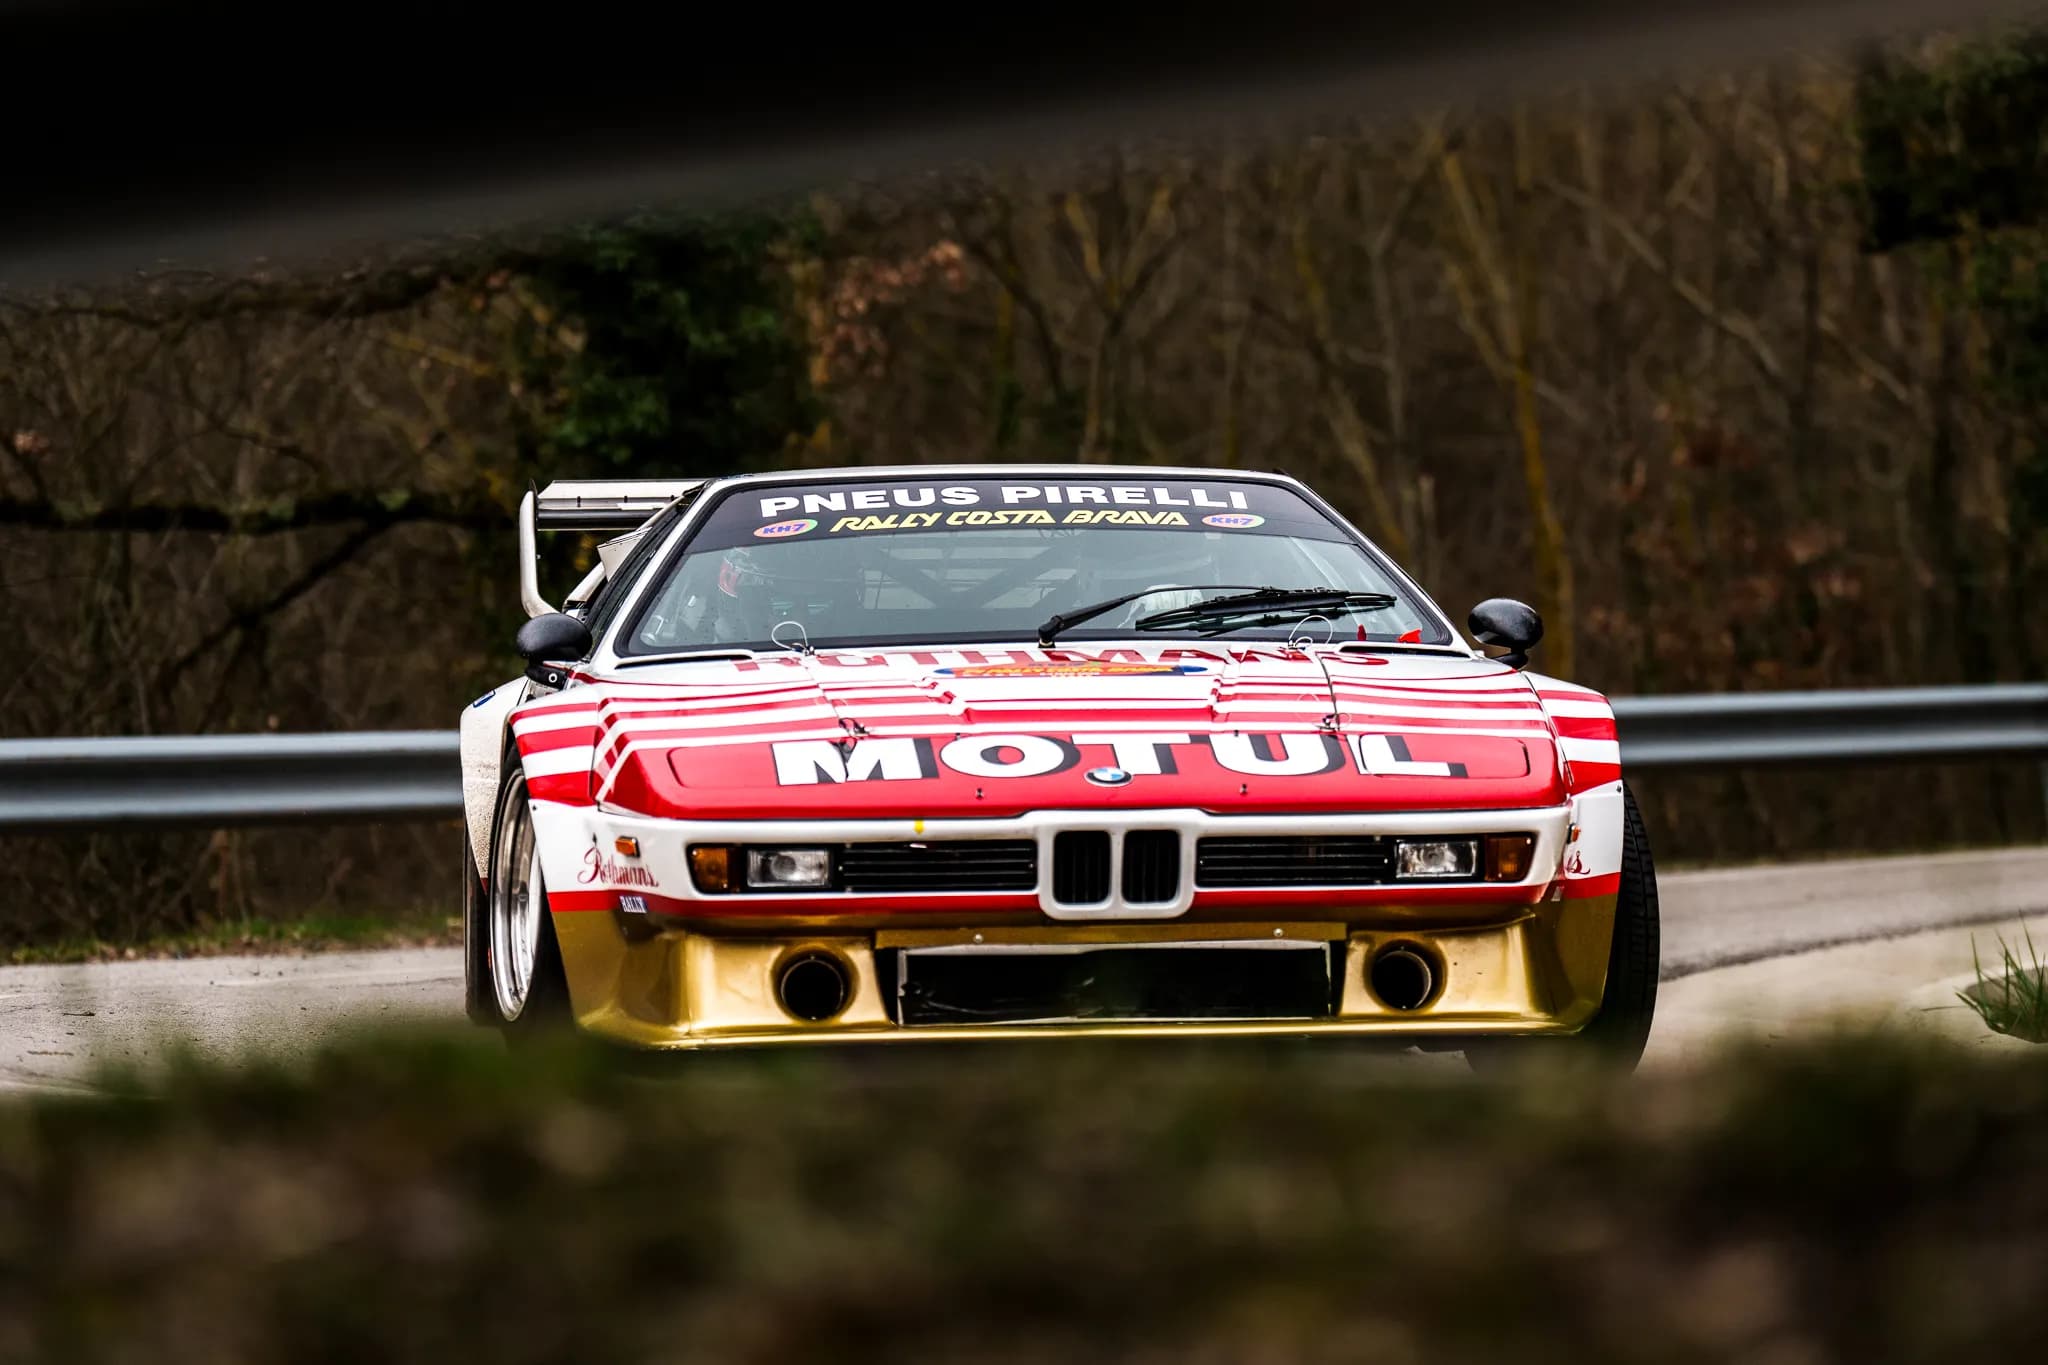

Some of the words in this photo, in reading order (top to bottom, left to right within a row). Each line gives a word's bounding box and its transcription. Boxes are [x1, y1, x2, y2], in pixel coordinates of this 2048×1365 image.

[760, 486, 980, 518] PNEUS
[1000, 485, 1249, 510] PIRELLI
[830, 511, 942, 533] RALLY
[946, 509, 1056, 526] COSTA
[1062, 509, 1189, 526] BRAVA
[771, 733, 1468, 786] MOTUL
